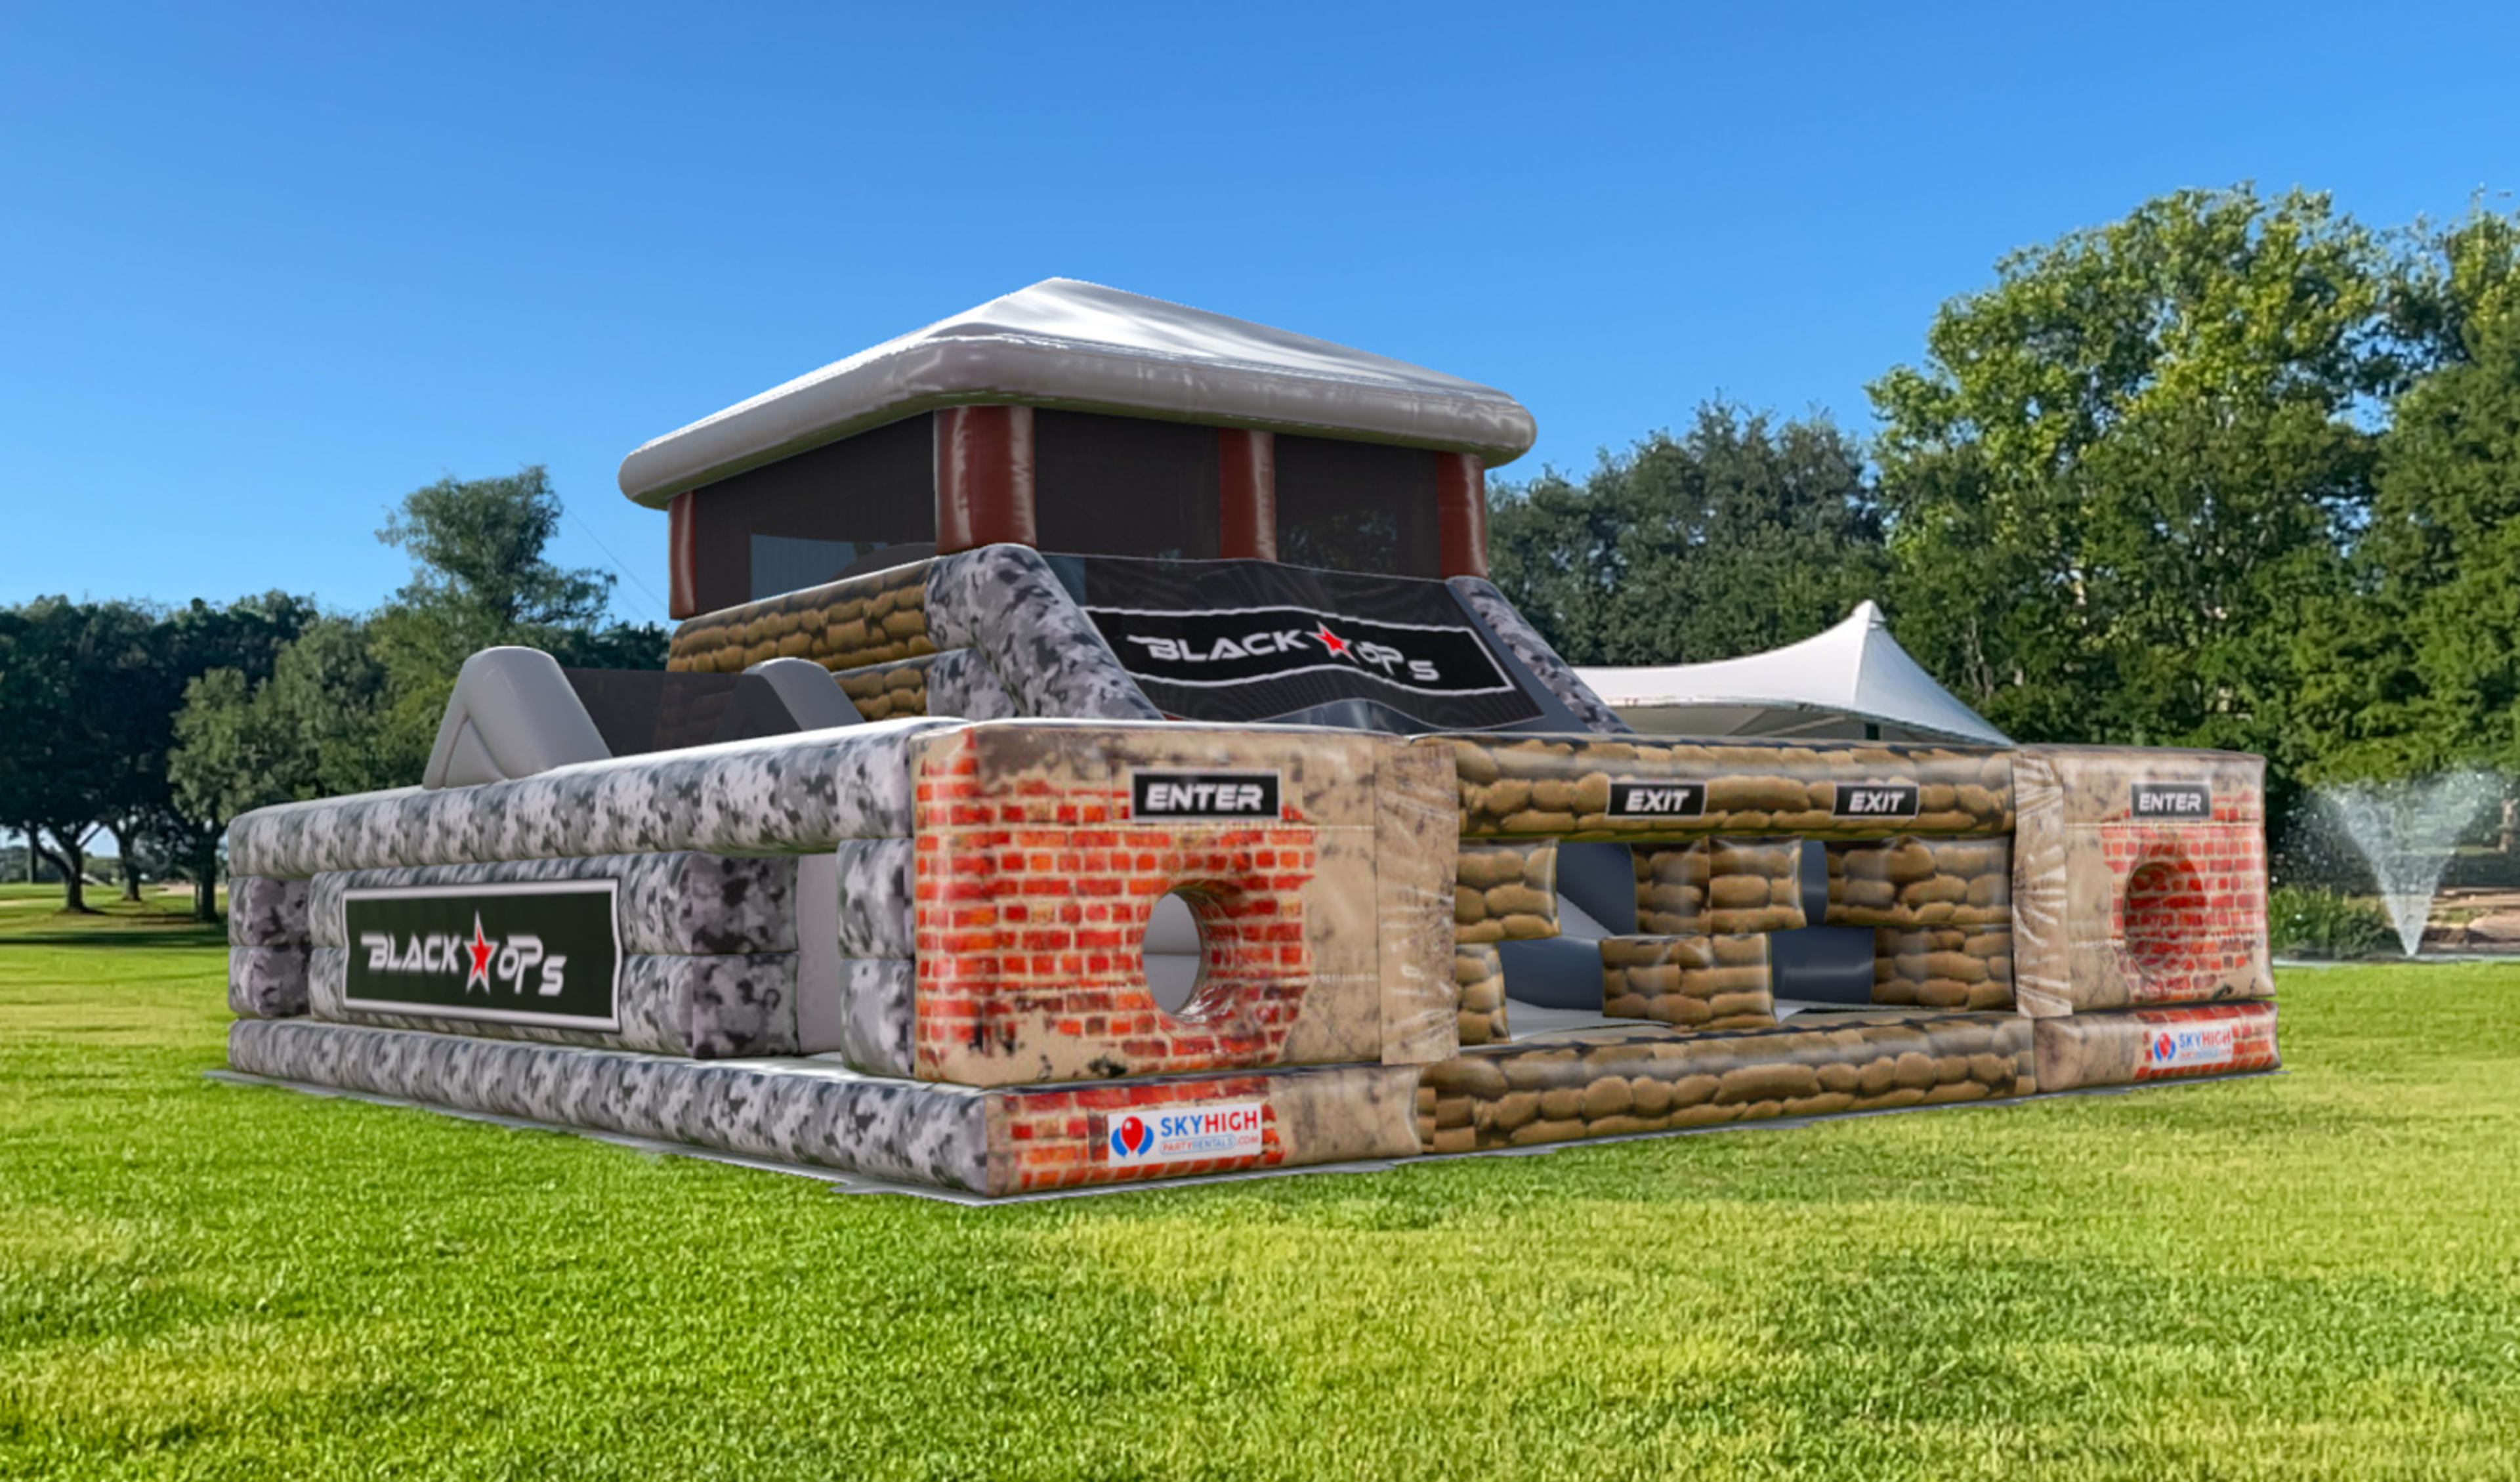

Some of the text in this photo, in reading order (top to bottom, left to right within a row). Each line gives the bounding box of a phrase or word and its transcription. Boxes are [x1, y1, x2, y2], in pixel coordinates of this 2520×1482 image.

[1127, 629, 1310, 662] BLACK
[1145, 782, 1263, 811] ENTER
[1625, 789, 1690, 812] EXIT
[1849, 791, 1904, 813] EXIT
[2139, 792, 2201, 811] ENTER
[360, 933, 461, 973] BLACK
[2179, 1030, 2230, 1049] SKYHIGH
[1160, 1111, 1257, 1137] SKYHIGH
